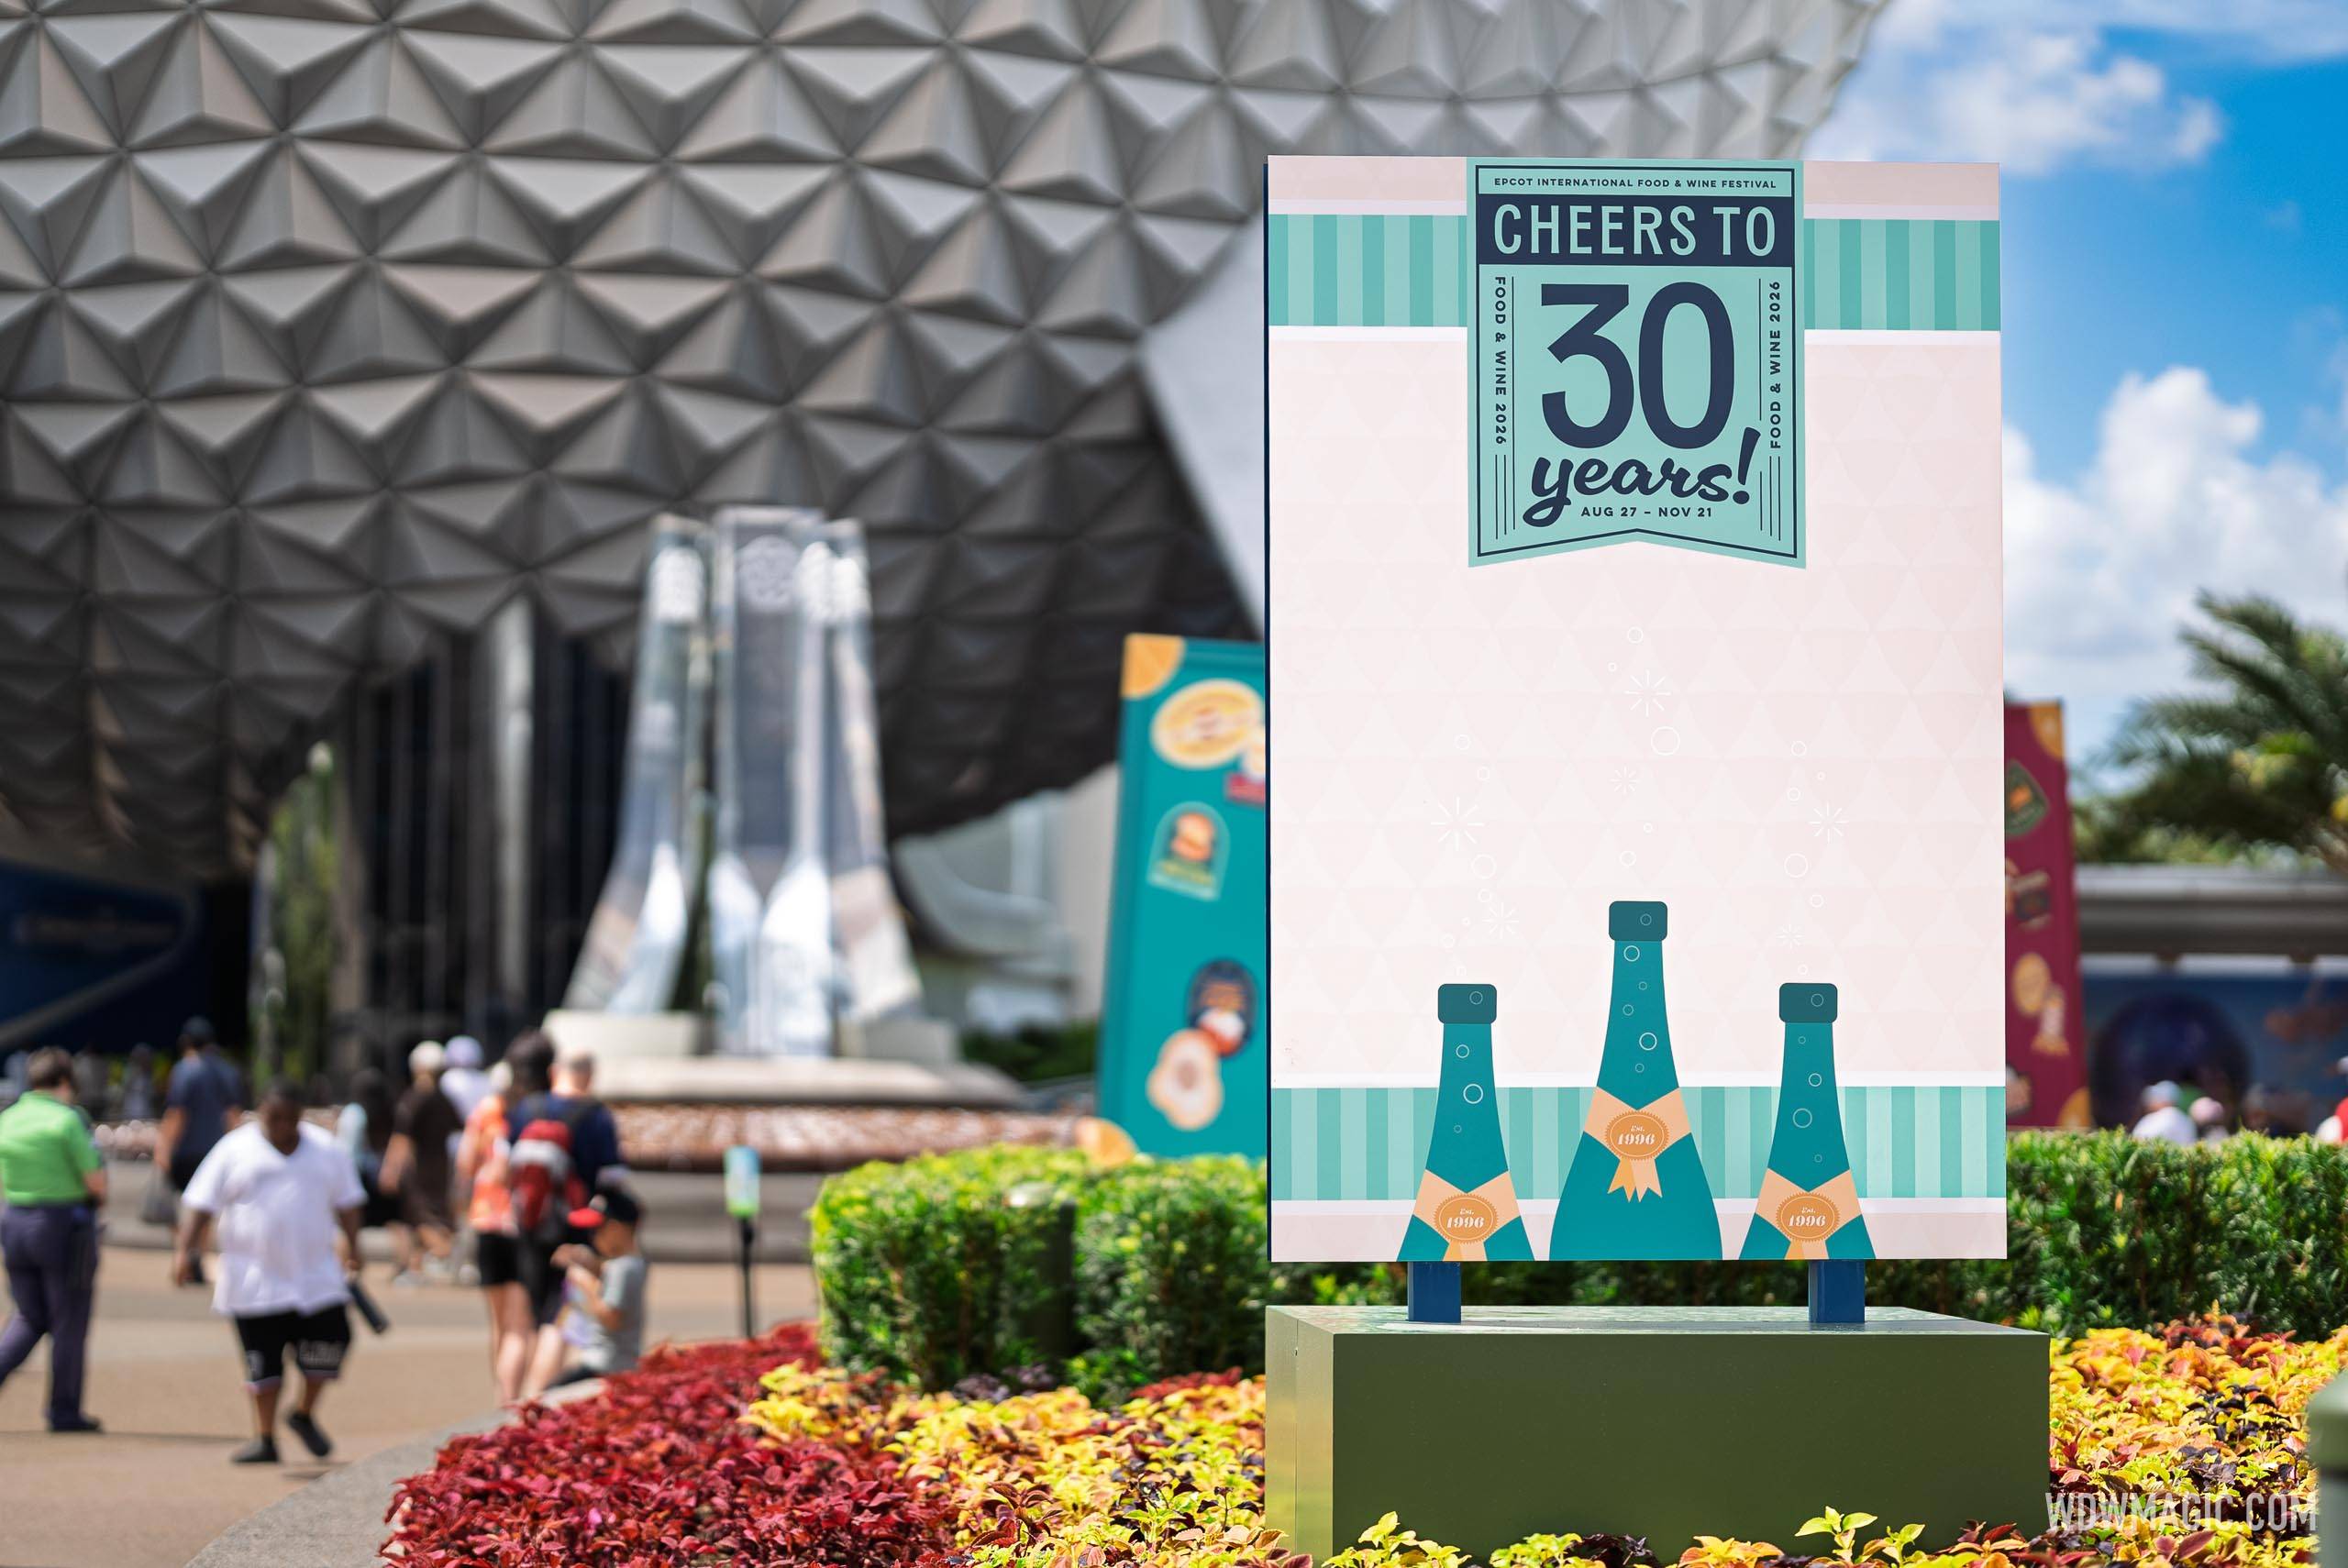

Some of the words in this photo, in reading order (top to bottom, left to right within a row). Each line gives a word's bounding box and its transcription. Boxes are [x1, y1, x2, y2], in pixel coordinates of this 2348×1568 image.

[1494, 177, 1534, 186] EPCOT
[1537, 178, 1634, 187] INTERNATIONAL
[1637, 179, 1670, 188] FOOD
[1674, 179, 1682, 188] &
[1686, 179, 1717, 188] WINE
[1722, 180, 1777, 189] FESTIVAL
[1494, 204, 1697, 256] CHEERS
[1712, 205, 1776, 257] TO
[1494, 276, 1506, 325] FOOD
[1769, 282, 1781, 323] 2026
[1495, 332, 1507, 343] &
[1769, 329, 1781, 376] WINE
[1495, 349, 1507, 396] WINE
[1541, 282, 1735, 450] 30
[1769, 382, 1781, 394] &
[1495, 403, 1507, 445] 2026
[1769, 401, 1781, 449] FOOD
[1523, 426, 1761, 527] years!
[1580, 506, 1614, 517] AUG
[1620, 506, 1637, 517] 27
[1658, 507, 1691, 517] NOV
[1697, 507, 1711, 517] 21
[1617, 1133, 1656, 1145] 1996
[1446, 1217, 1484, 1229] 1996
[1789, 1215, 1826, 1227] 1996
